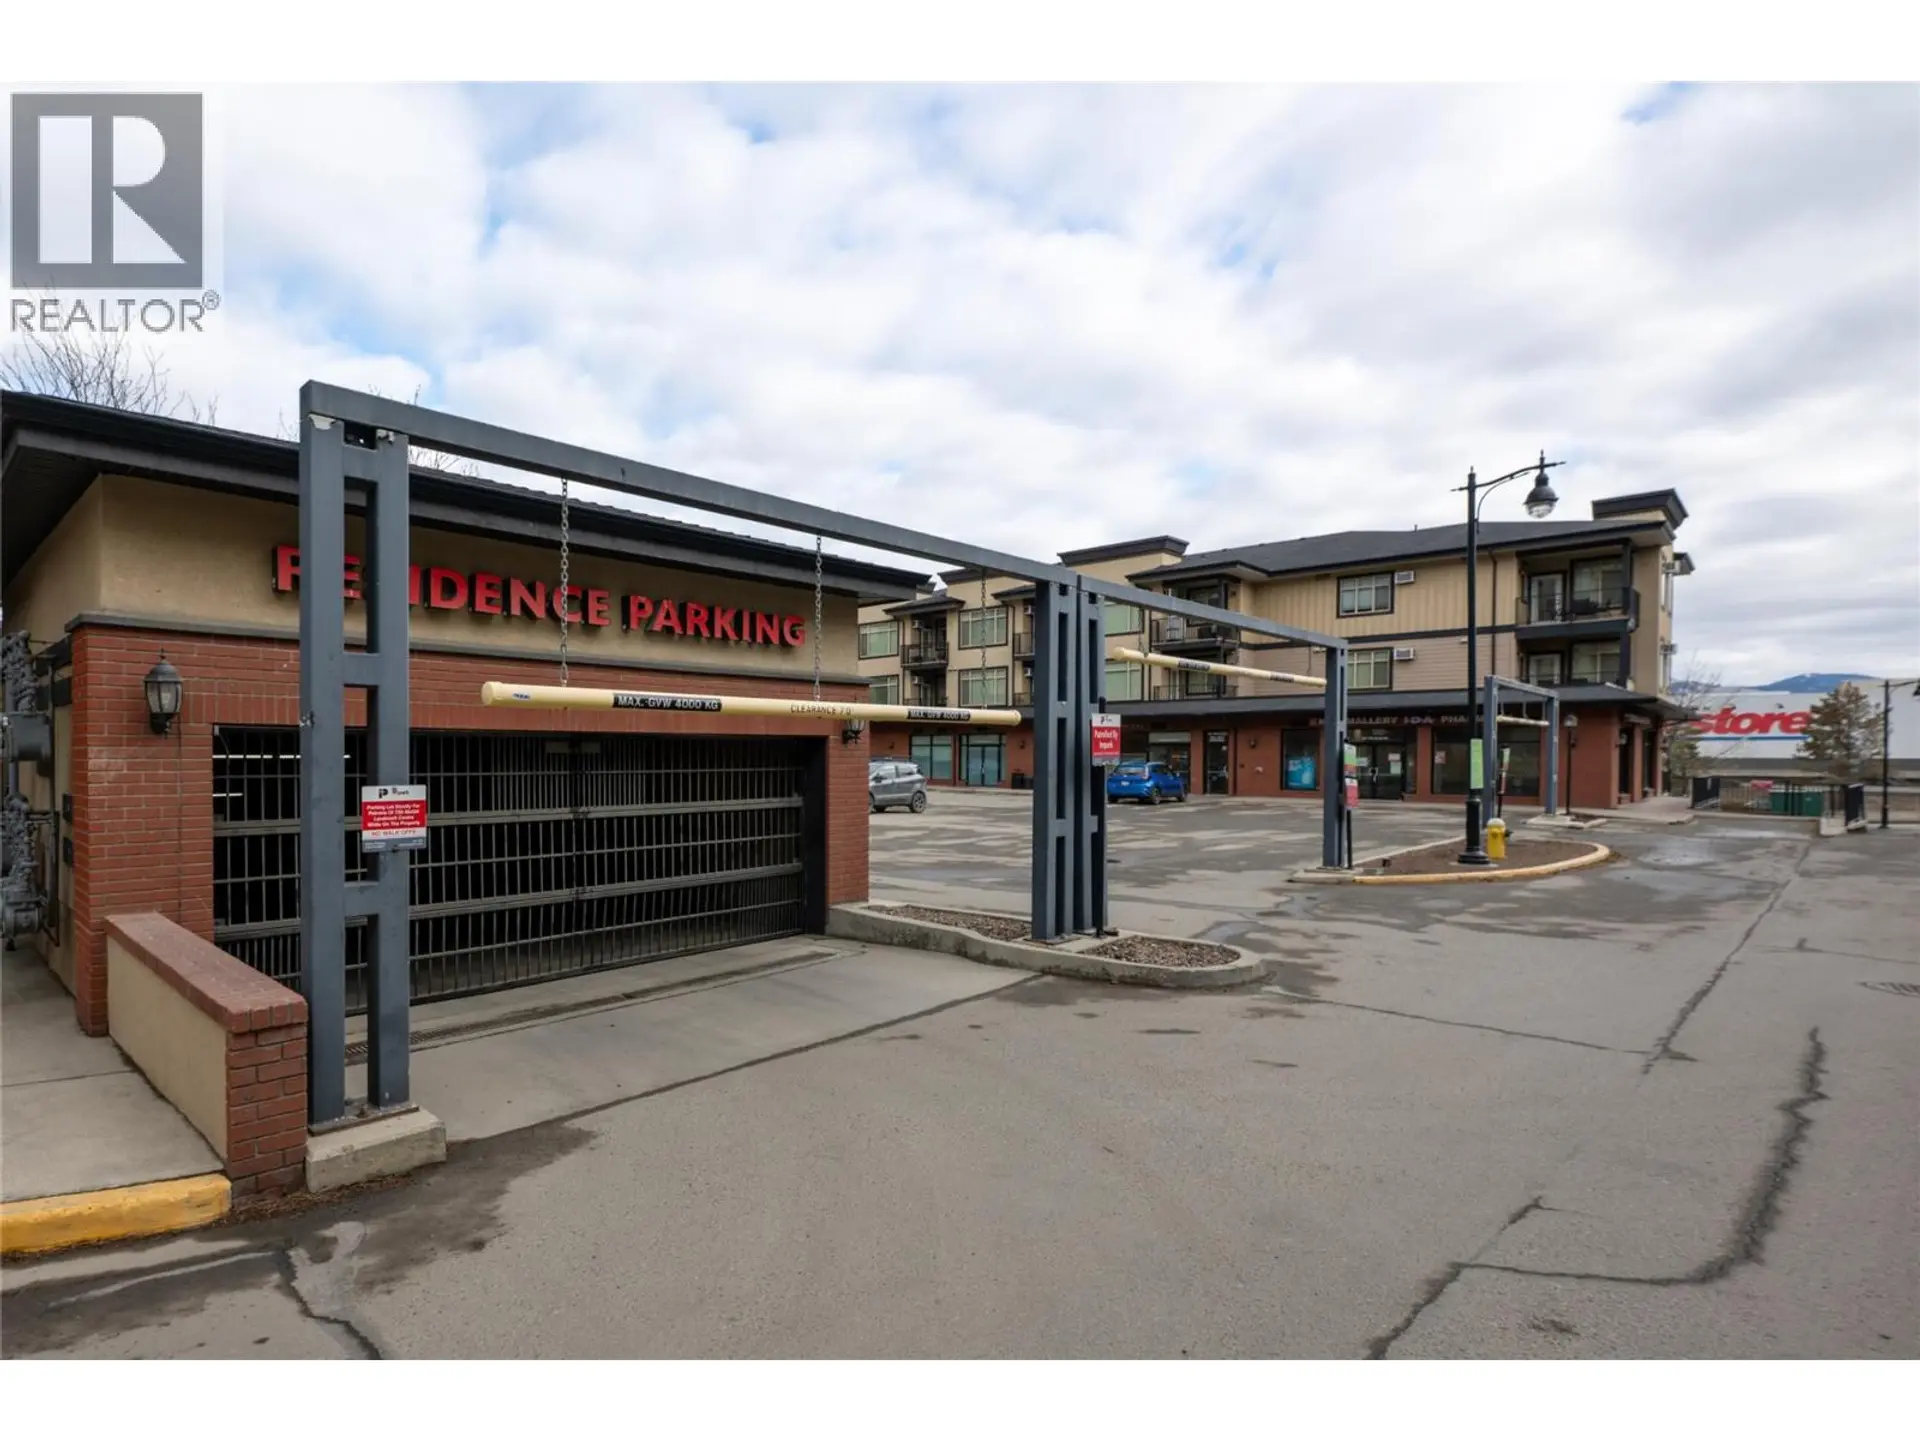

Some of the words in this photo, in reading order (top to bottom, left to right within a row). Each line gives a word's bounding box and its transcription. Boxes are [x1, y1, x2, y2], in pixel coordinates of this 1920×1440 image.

[273, 543, 612, 628] REIDENCE
[622, 594, 807, 648] PARKING
[617, 694, 644, 706] MAX.
[648, 696, 671, 708] GVW
[675, 697, 700, 709] 4000
[704, 699, 719, 711] KG
[790, 704, 837, 717] CLEARANCE
